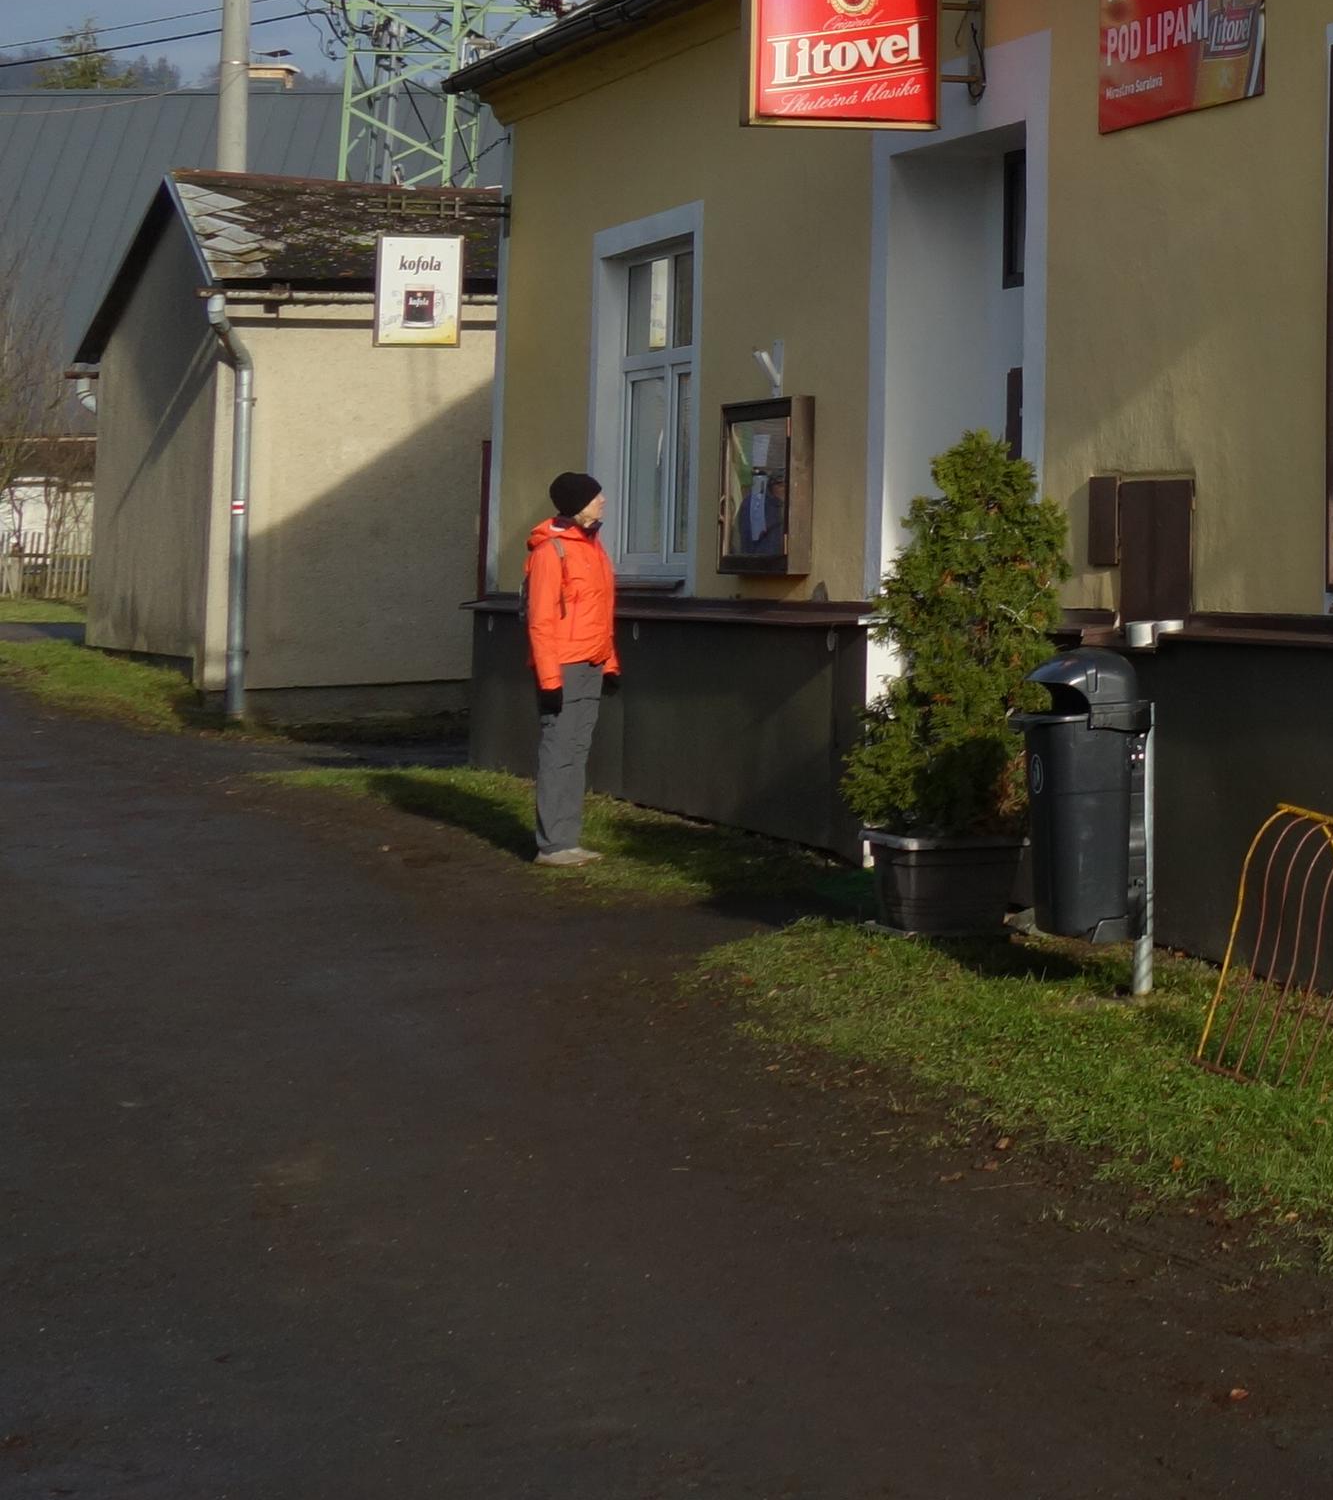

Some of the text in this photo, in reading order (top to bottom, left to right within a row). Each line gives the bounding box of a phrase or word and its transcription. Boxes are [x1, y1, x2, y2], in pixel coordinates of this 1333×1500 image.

[771, 23, 921, 85] Litovel
[1106, 0, 1209, 67] POD LIPAMI
[774, 77, 921, 114] Skutečná klasika
[399, 255, 441, 275] kofola
